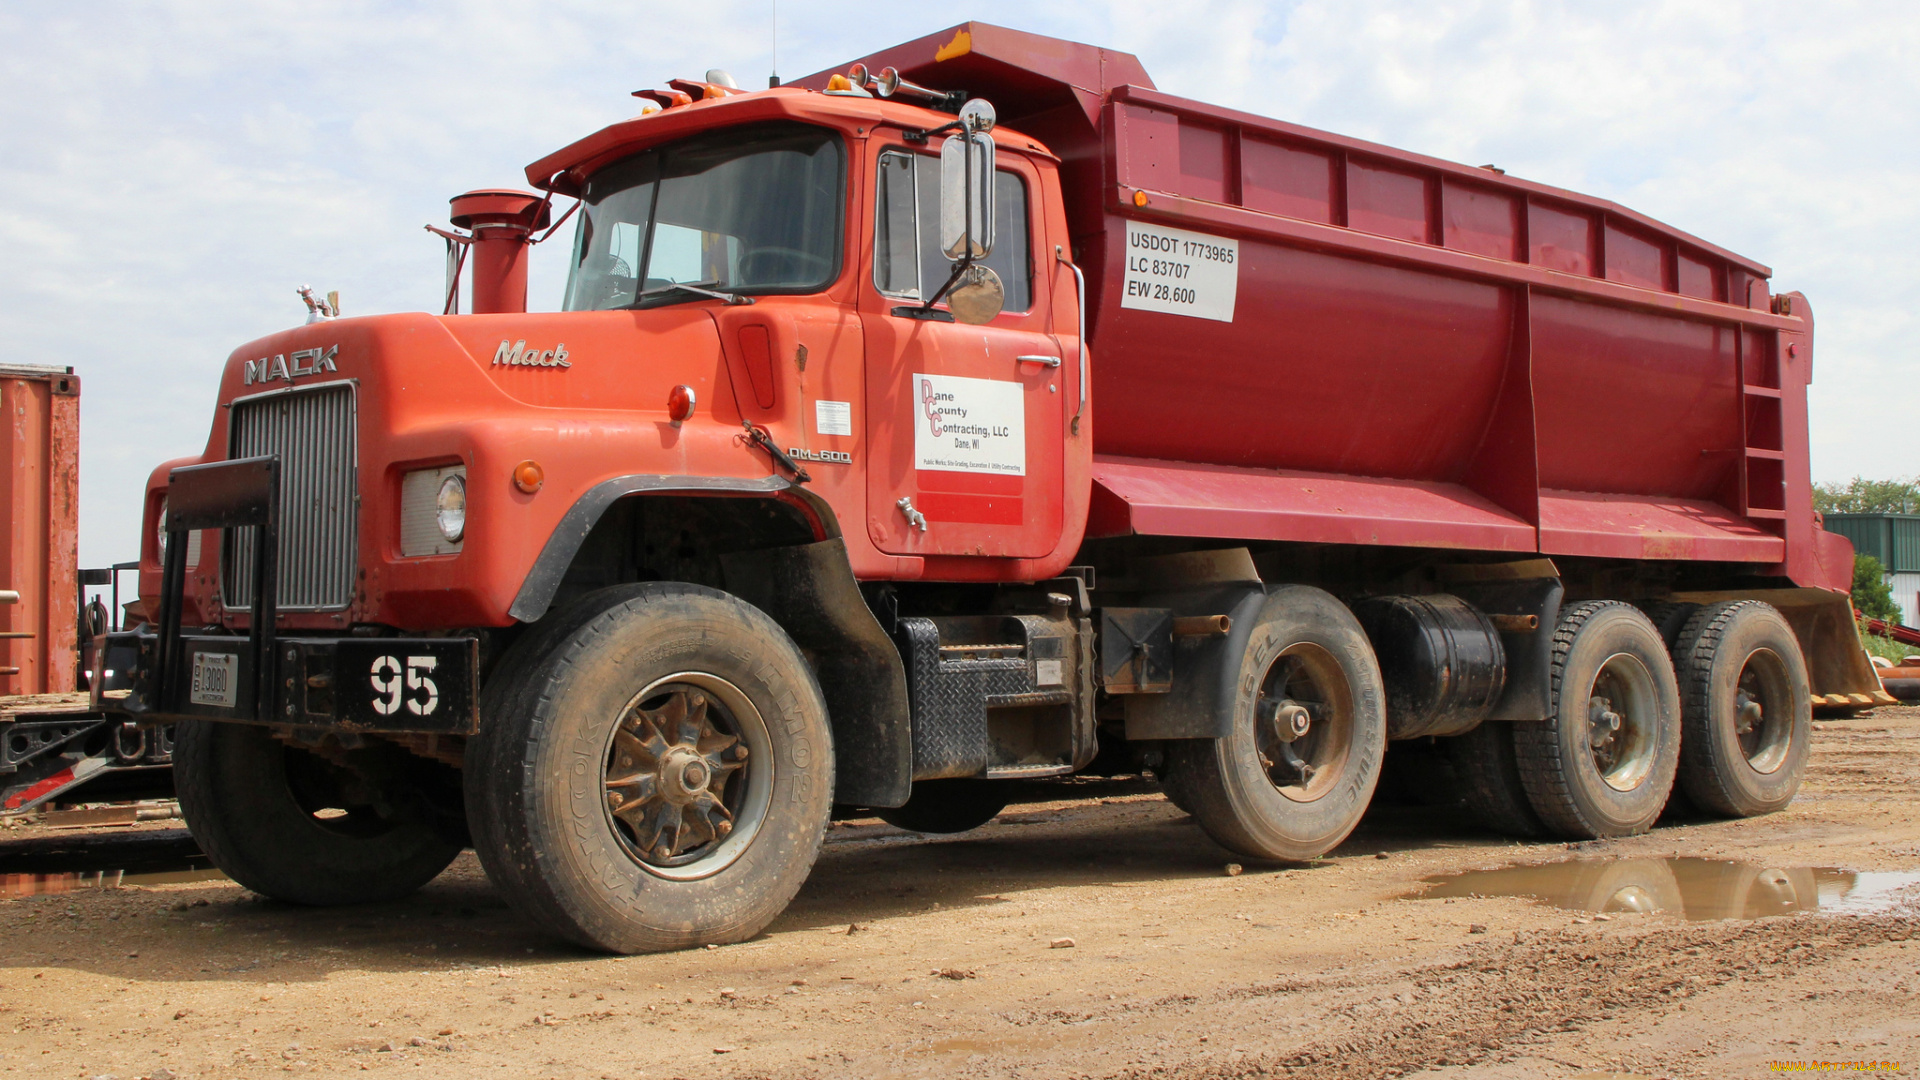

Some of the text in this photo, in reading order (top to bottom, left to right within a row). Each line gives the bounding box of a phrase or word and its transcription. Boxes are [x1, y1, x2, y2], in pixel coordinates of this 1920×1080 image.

[1131, 232, 1234, 264] USDOT 1773965
[1130, 256, 1190, 279] LC 83707
[1128, 280, 1196, 304] EW 28,600
[244, 343, 339, 386] MACK
[492, 339, 572, 368] Mack
[921, 379, 954, 403] Dane
[925, 396, 967, 419] County
[930, 412, 1009, 438] Contracting, LLC
[789, 447, 851, 462] DM-600
[955, 438, 980, 450] Dane, WI
[1002, 463, 1021, 472] Contracting
[1253, 633, 1279, 669] EL
[202, 667, 227, 692] 13080
[371, 655, 438, 716] 95
